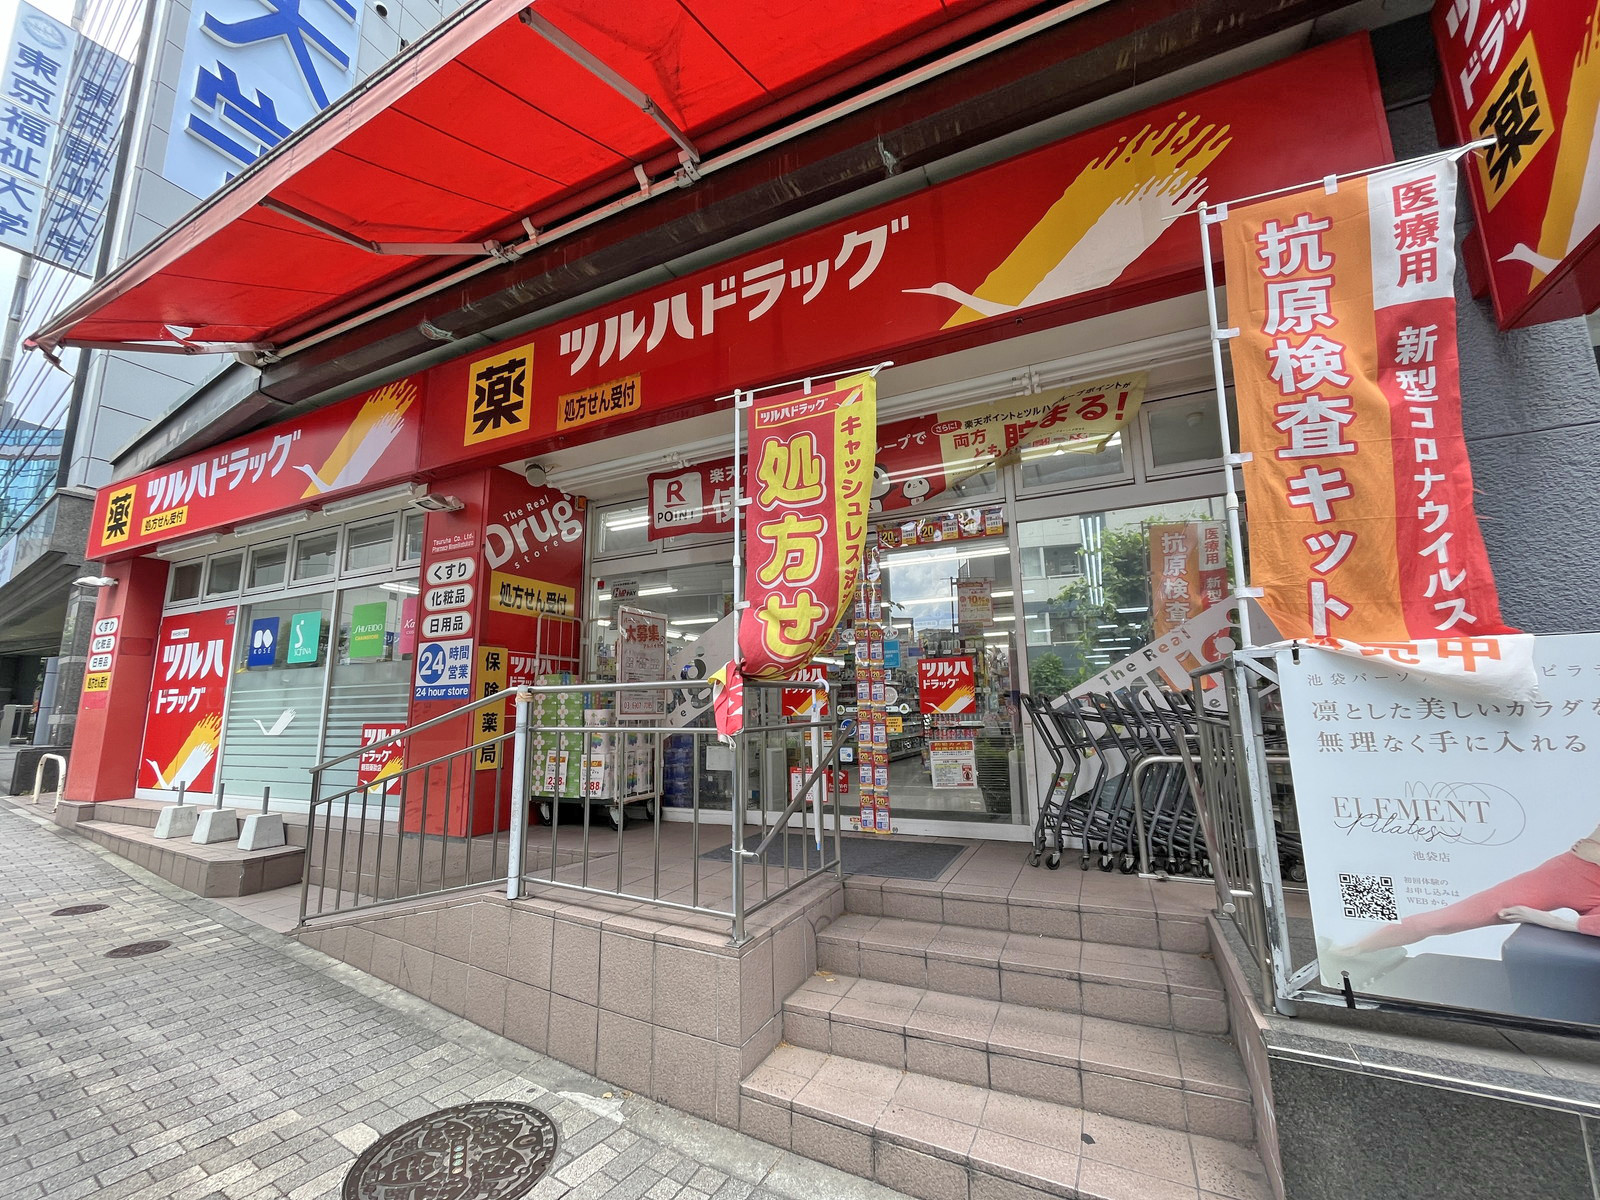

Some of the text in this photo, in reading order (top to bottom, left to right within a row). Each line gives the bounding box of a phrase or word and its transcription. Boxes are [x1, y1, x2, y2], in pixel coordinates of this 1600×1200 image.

[1479, 57, 1544, 193] 薬
[0, 42, 62, 238] 東京福祉大学
[1391, 173, 1440, 288] 医療用
[559, 215, 909, 377] ツルハドラッグ
[472, 357, 526, 436] 薬
[563, 380, 636, 420] 処方せん受付
[760, 397, 829, 424] ツルハドラッグ
[1255, 213, 1354, 637] 抗原検査キット
[875, 430, 927, 455] ープで
[953, 428, 988, 451] 両方
[146, 429, 302, 514] ツルハドラッグ
[1394, 324, 1478, 631] 新型コロナウイルス
[105, 491, 133, 541] 薬
[144, 509, 184, 532] 処方せん受付
[503, 495, 549, 522] The Real
[840, 415, 863, 604] キャッシュレス決
[485, 493, 583, 570] Drug
[514, 540, 559, 570] store
[755, 430, 829, 682] 処方せ
[1204, 527, 1220, 565] 医療用
[433, 562, 467, 580] くすり
[1161, 532, 1191, 632] 抗原検査
[431, 588, 465, 607] 化粧品
[499, 581, 568, 616] 処方せん受付
[1206, 576, 1222, 607] 新型
[98, 621, 115, 632] くすり
[429, 615, 464, 634] 日用品
[626, 624, 660, 642] 大募集
[162, 639, 225, 682] ツルハ
[419, 651, 445, 676] 24
[448, 644, 470, 661] 時間
[448, 664, 469, 680] 営業
[921, 660, 970, 677] ツルハ
[1099, 661, 1137, 686] The
[1307, 671, 1428, 687] 池袋パーソ
[416, 684, 469, 697] 24 hour store
[922, 678, 959, 690] ドラッグ
[155, 686, 206, 714] ドラッグ
[480, 651, 501, 765] 保険薬局
[1317, 731, 1587, 753] 無理なく手に入れる
[1331, 795, 1491, 825] ELEMENT
[1333, 811, 1462, 843] Pilates
[1413, 851, 1451, 863] 池袋店
[1404, 876, 1449, 886] 初回体験の
[1405, 887, 1460, 897] お申し込みは
